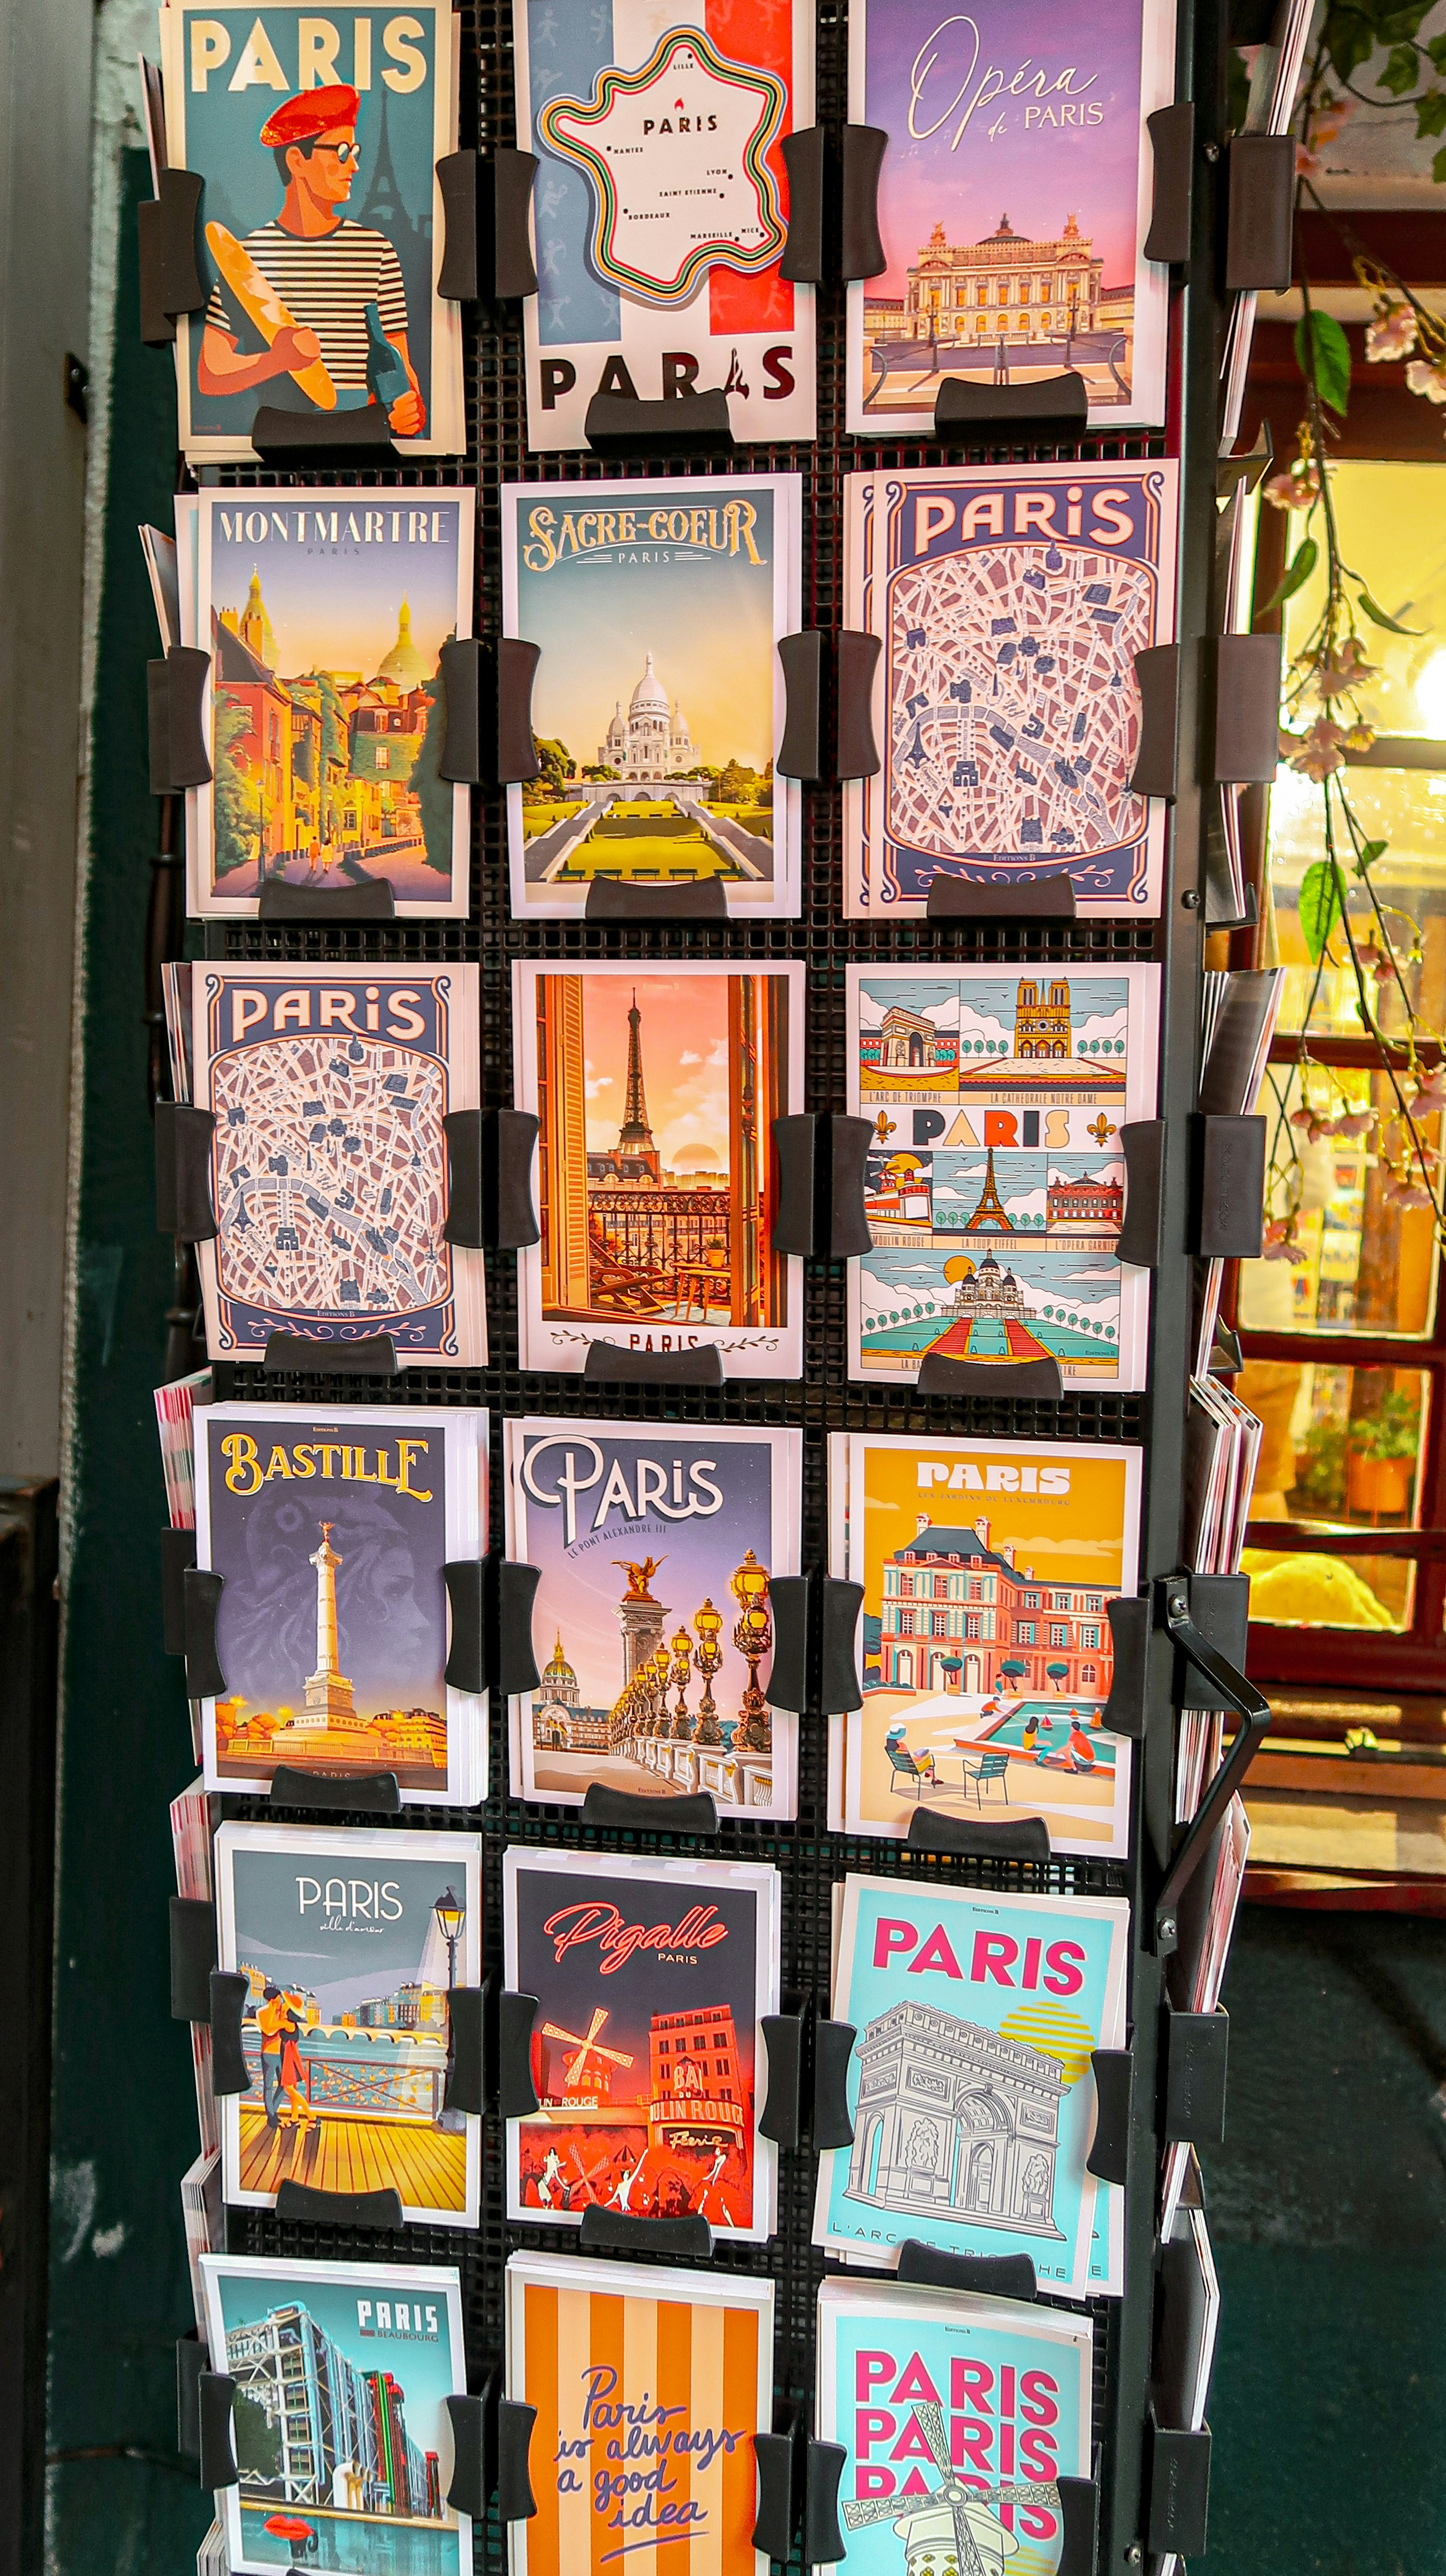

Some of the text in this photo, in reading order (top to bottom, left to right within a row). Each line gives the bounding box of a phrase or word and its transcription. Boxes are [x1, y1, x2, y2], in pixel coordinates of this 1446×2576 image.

[190, 16, 427, 93] PARIS
[907, 15, 1098, 152] Opéra
[643, 114, 718, 136] PARIS
[987, 102, 1104, 142] de PARIS
[684, 188, 717, 196] ETIENNE
[628, 212, 670, 221] BORDEAUX
[690, 231, 733, 240] MARSEILLE
[219, 511, 450, 543] MONTMARTRE
[523, 498, 768, 573] SACRE-COEUR
[307, 548, 360, 556] PARIS
[618, 551, 670, 564] PARIS
[1030, 854, 1036, 862] B
[869, 1091, 941, 1103] L'ARC DE TRIOMPHE
[990, 1092, 1098, 1105] LA CATHEDRALE NOTRE DAME
[912, 1109, 1070, 1149] PARIS
[902, 1236, 925, 1247] ROUGE
[962, 1238, 970, 1248] LA
[994, 1239, 1018, 1250] EIFFEL
[1055, 1240, 1085, 1250] L'OPERA
[901, 1359, 909, 1369] LA
[221, 1433, 433, 1503] BASTILLE
[916, 1461, 1072, 1496] PARIS
[939, 1493, 982, 1501] JARDINS
[1003, 1497, 1070, 1507] LUXEMBOURG
[567, 1524, 667, 1560] LE PONT ALEXANDRE III
[294, 1876, 404, 1921] PARIS
[543, 1900, 729, 1976] Pigalle
[657, 1952, 698, 1965] PARIS
[873, 1917, 1086, 1997] PARIS
[562, 2096, 598, 2107] ROUGE
[832, 2221, 899, 2244] L'ARC
[357, 2299, 439, 2334] PARIS
[377, 2331, 440, 2344] BEAUBOURG
[581, 2365, 687, 2430] Paris
[855, 2349, 1060, 2428] PARIS
[553, 2424, 747, 2471] is always
[855, 2407, 1060, 2483] PARIS
[557, 2458, 678, 2512] a good
[608, 2493, 709, 2529] idea
